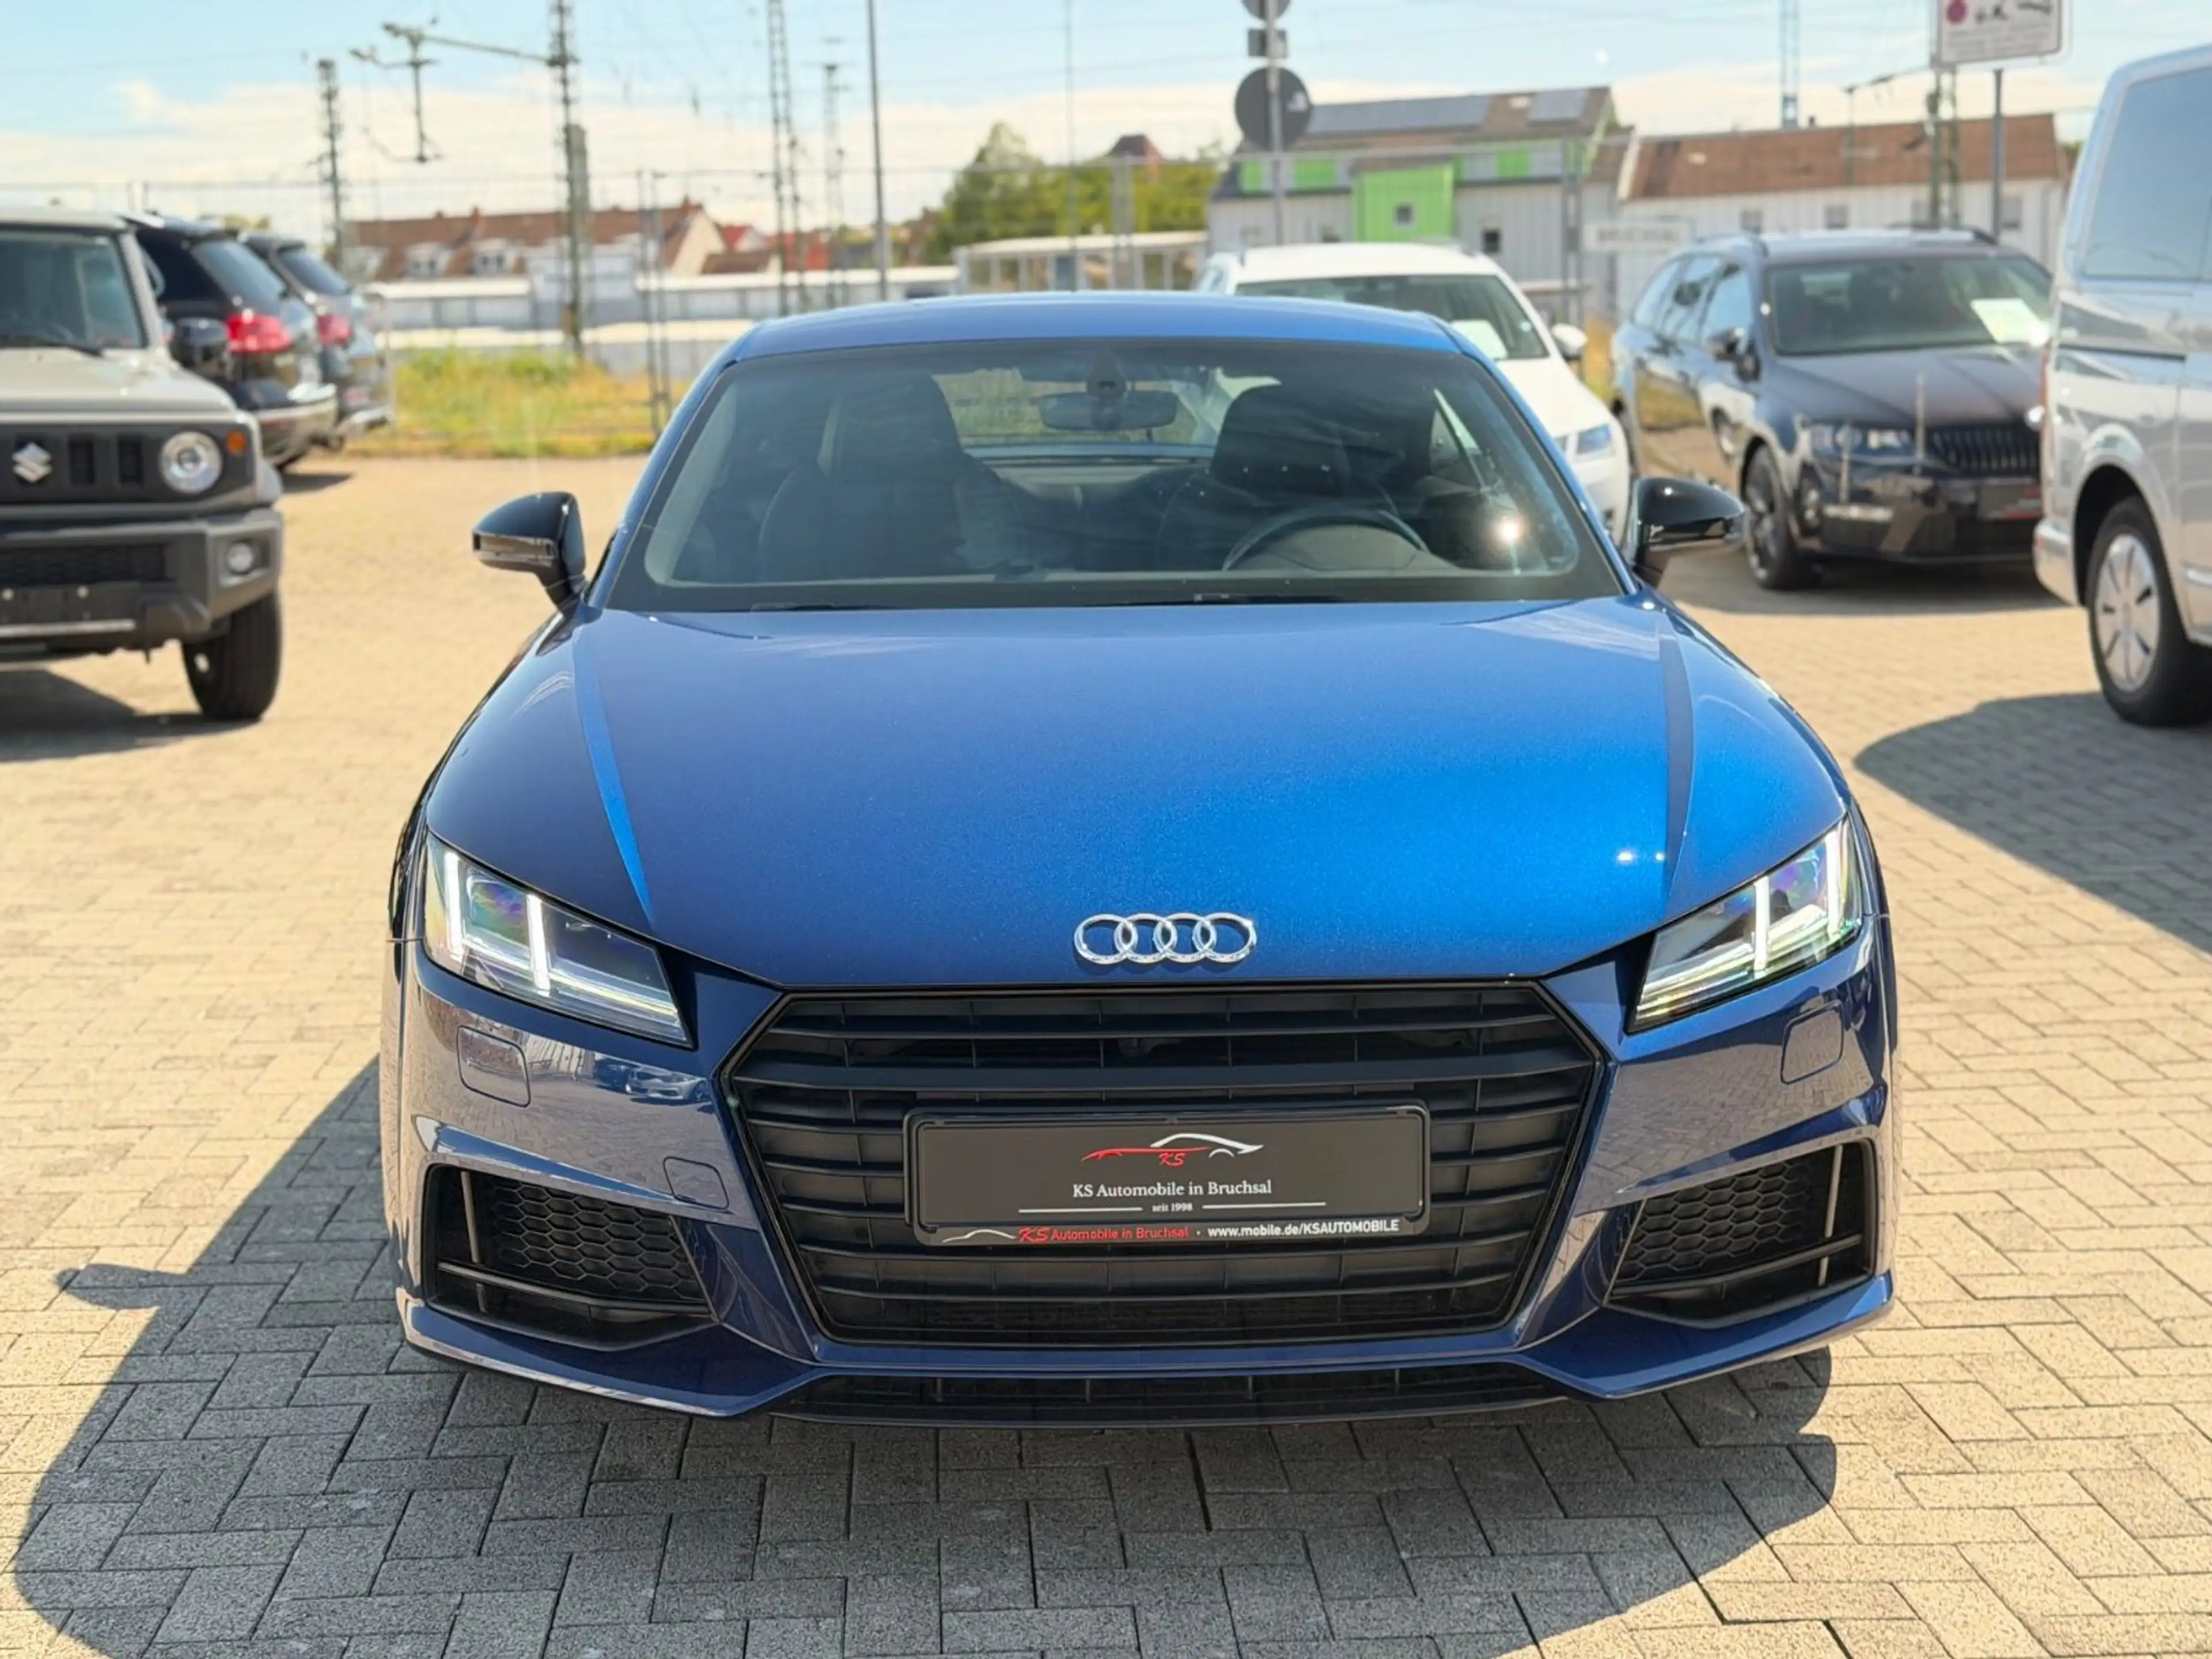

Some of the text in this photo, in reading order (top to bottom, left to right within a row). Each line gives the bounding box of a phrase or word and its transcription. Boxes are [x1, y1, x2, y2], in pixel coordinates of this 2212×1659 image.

[1158, 1152, 1185, 1166] KS
[1073, 1179, 1272, 1198] KS Automobile in Bruchsal
[1152, 1202, 1193, 1212] seit 1998
[1018, 1219, 1400, 1243] KS Automobile in Bruchsal www.mobile.de/KSAUTOMOBILE
